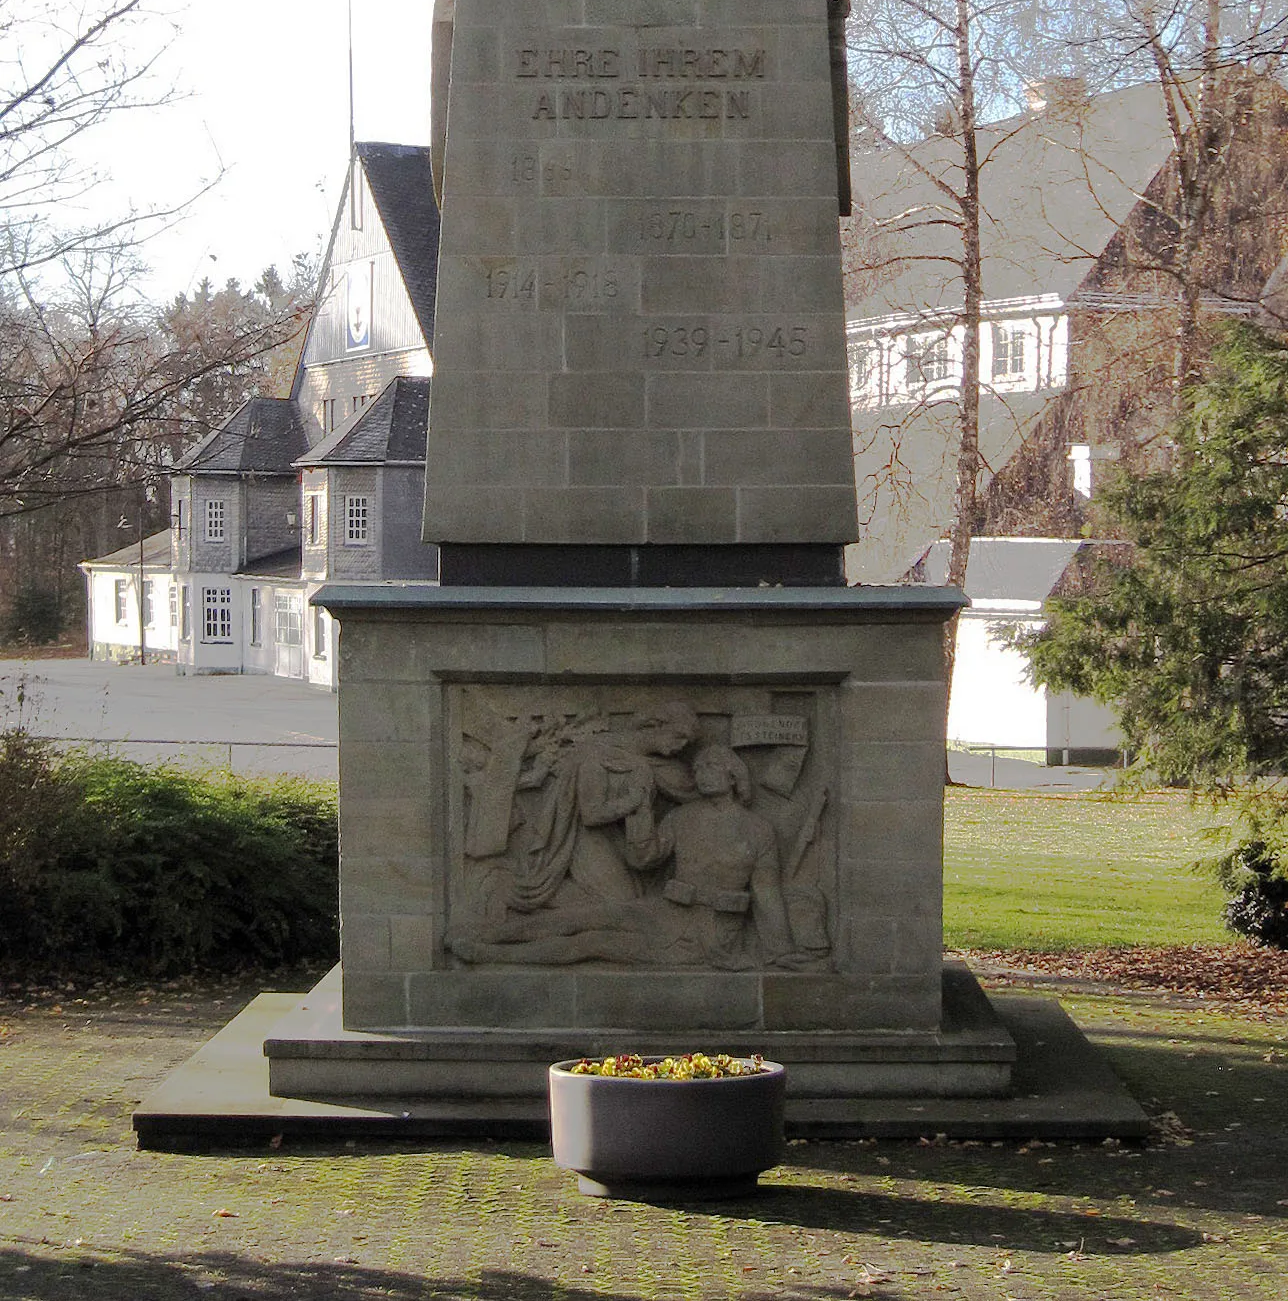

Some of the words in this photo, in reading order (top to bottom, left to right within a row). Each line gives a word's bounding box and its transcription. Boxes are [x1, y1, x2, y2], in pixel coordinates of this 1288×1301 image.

[516, 49, 620, 78] EHRE
[637, 49, 766, 78] IHREM
[531, 90, 752, 119] ANDENKEN
